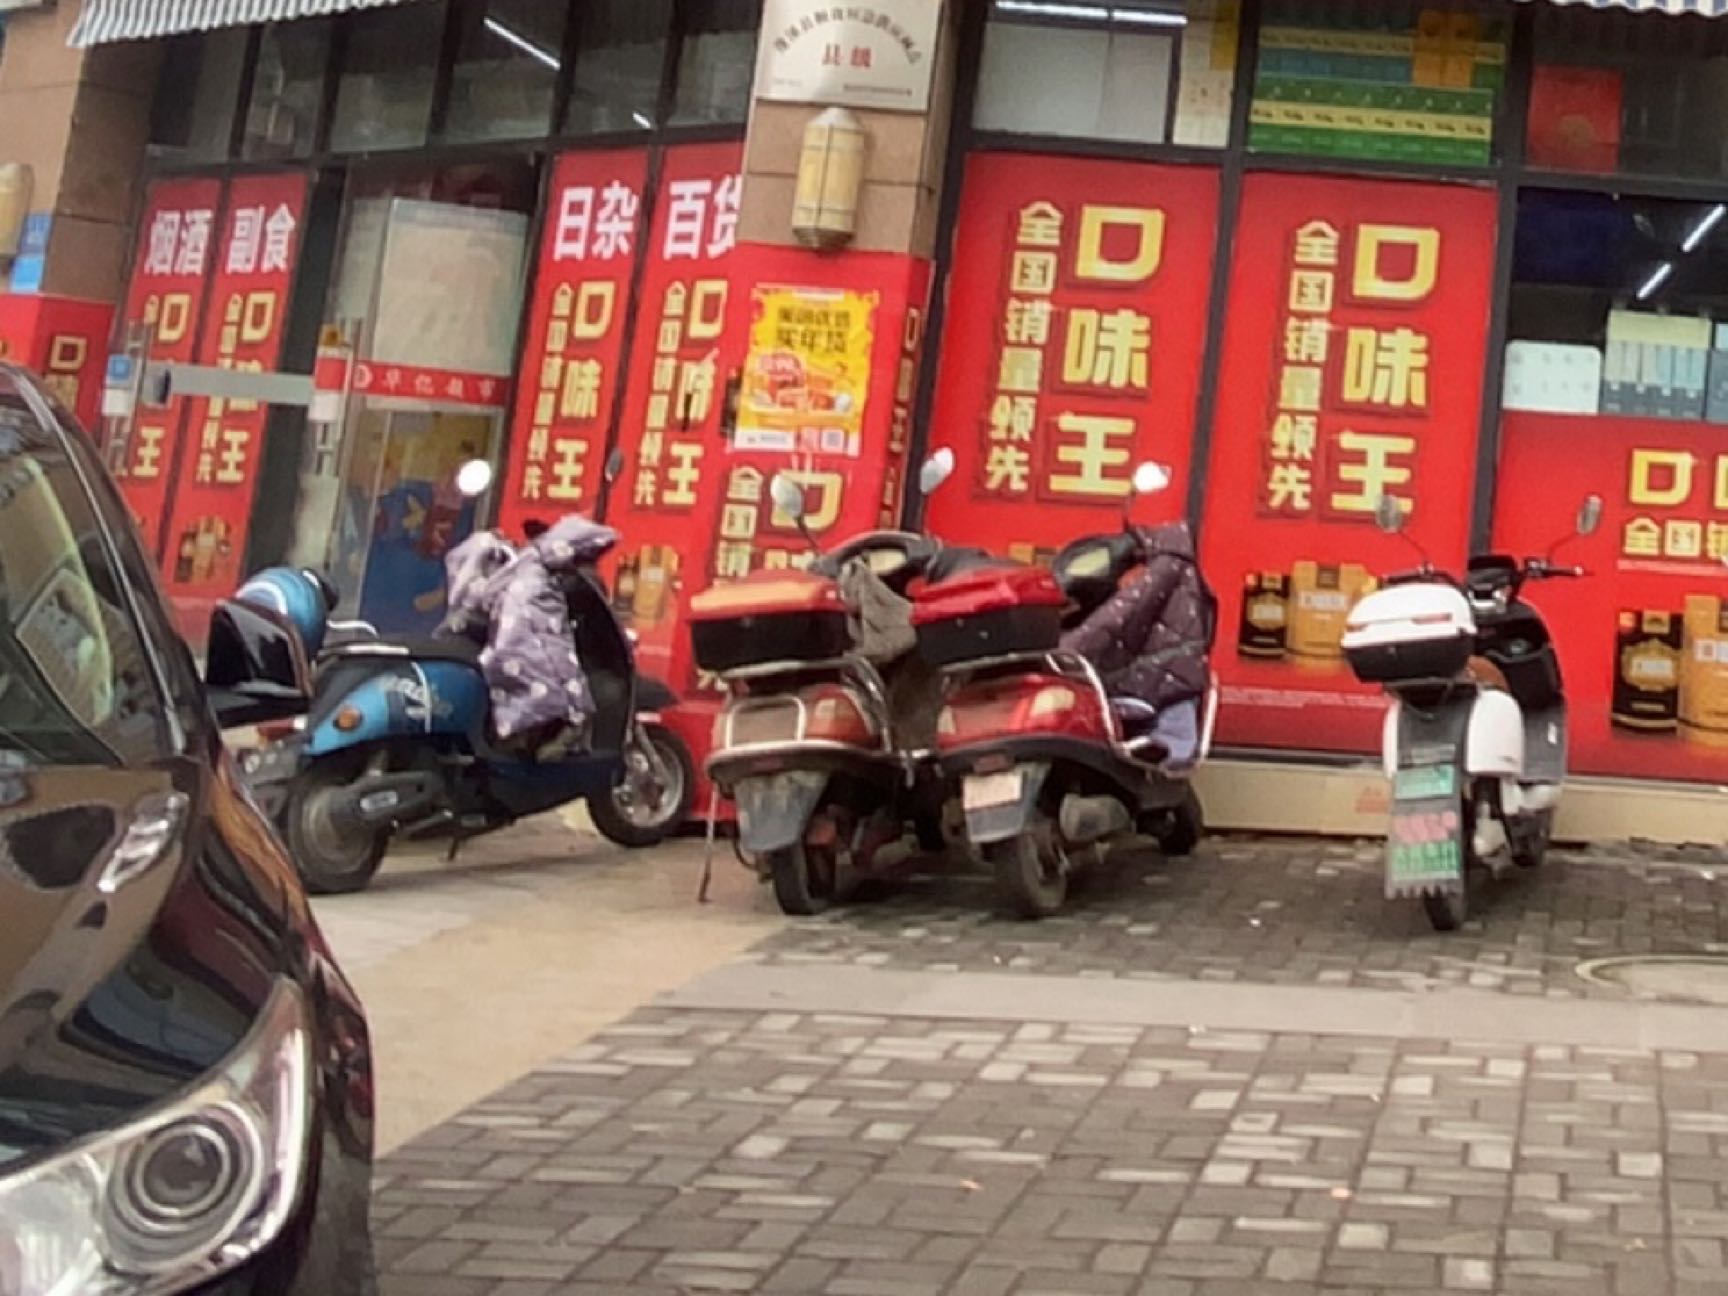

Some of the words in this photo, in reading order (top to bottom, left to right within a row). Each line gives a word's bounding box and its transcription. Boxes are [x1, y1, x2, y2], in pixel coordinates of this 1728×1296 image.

[144, 209, 212, 275] 烟酒
[226, 203, 295, 275] 副食
[554, 180, 640, 261] 日杂
[664, 175, 742, 260] 百货
[547, 280, 616, 500] 口味王
[986, 200, 1063, 492] 全国销量领先
[1049, 204, 1165, 495] 口味王
[1267, 220, 1339, 511] 全国销量领先
[1331, 224, 1440, 514] 口味王
